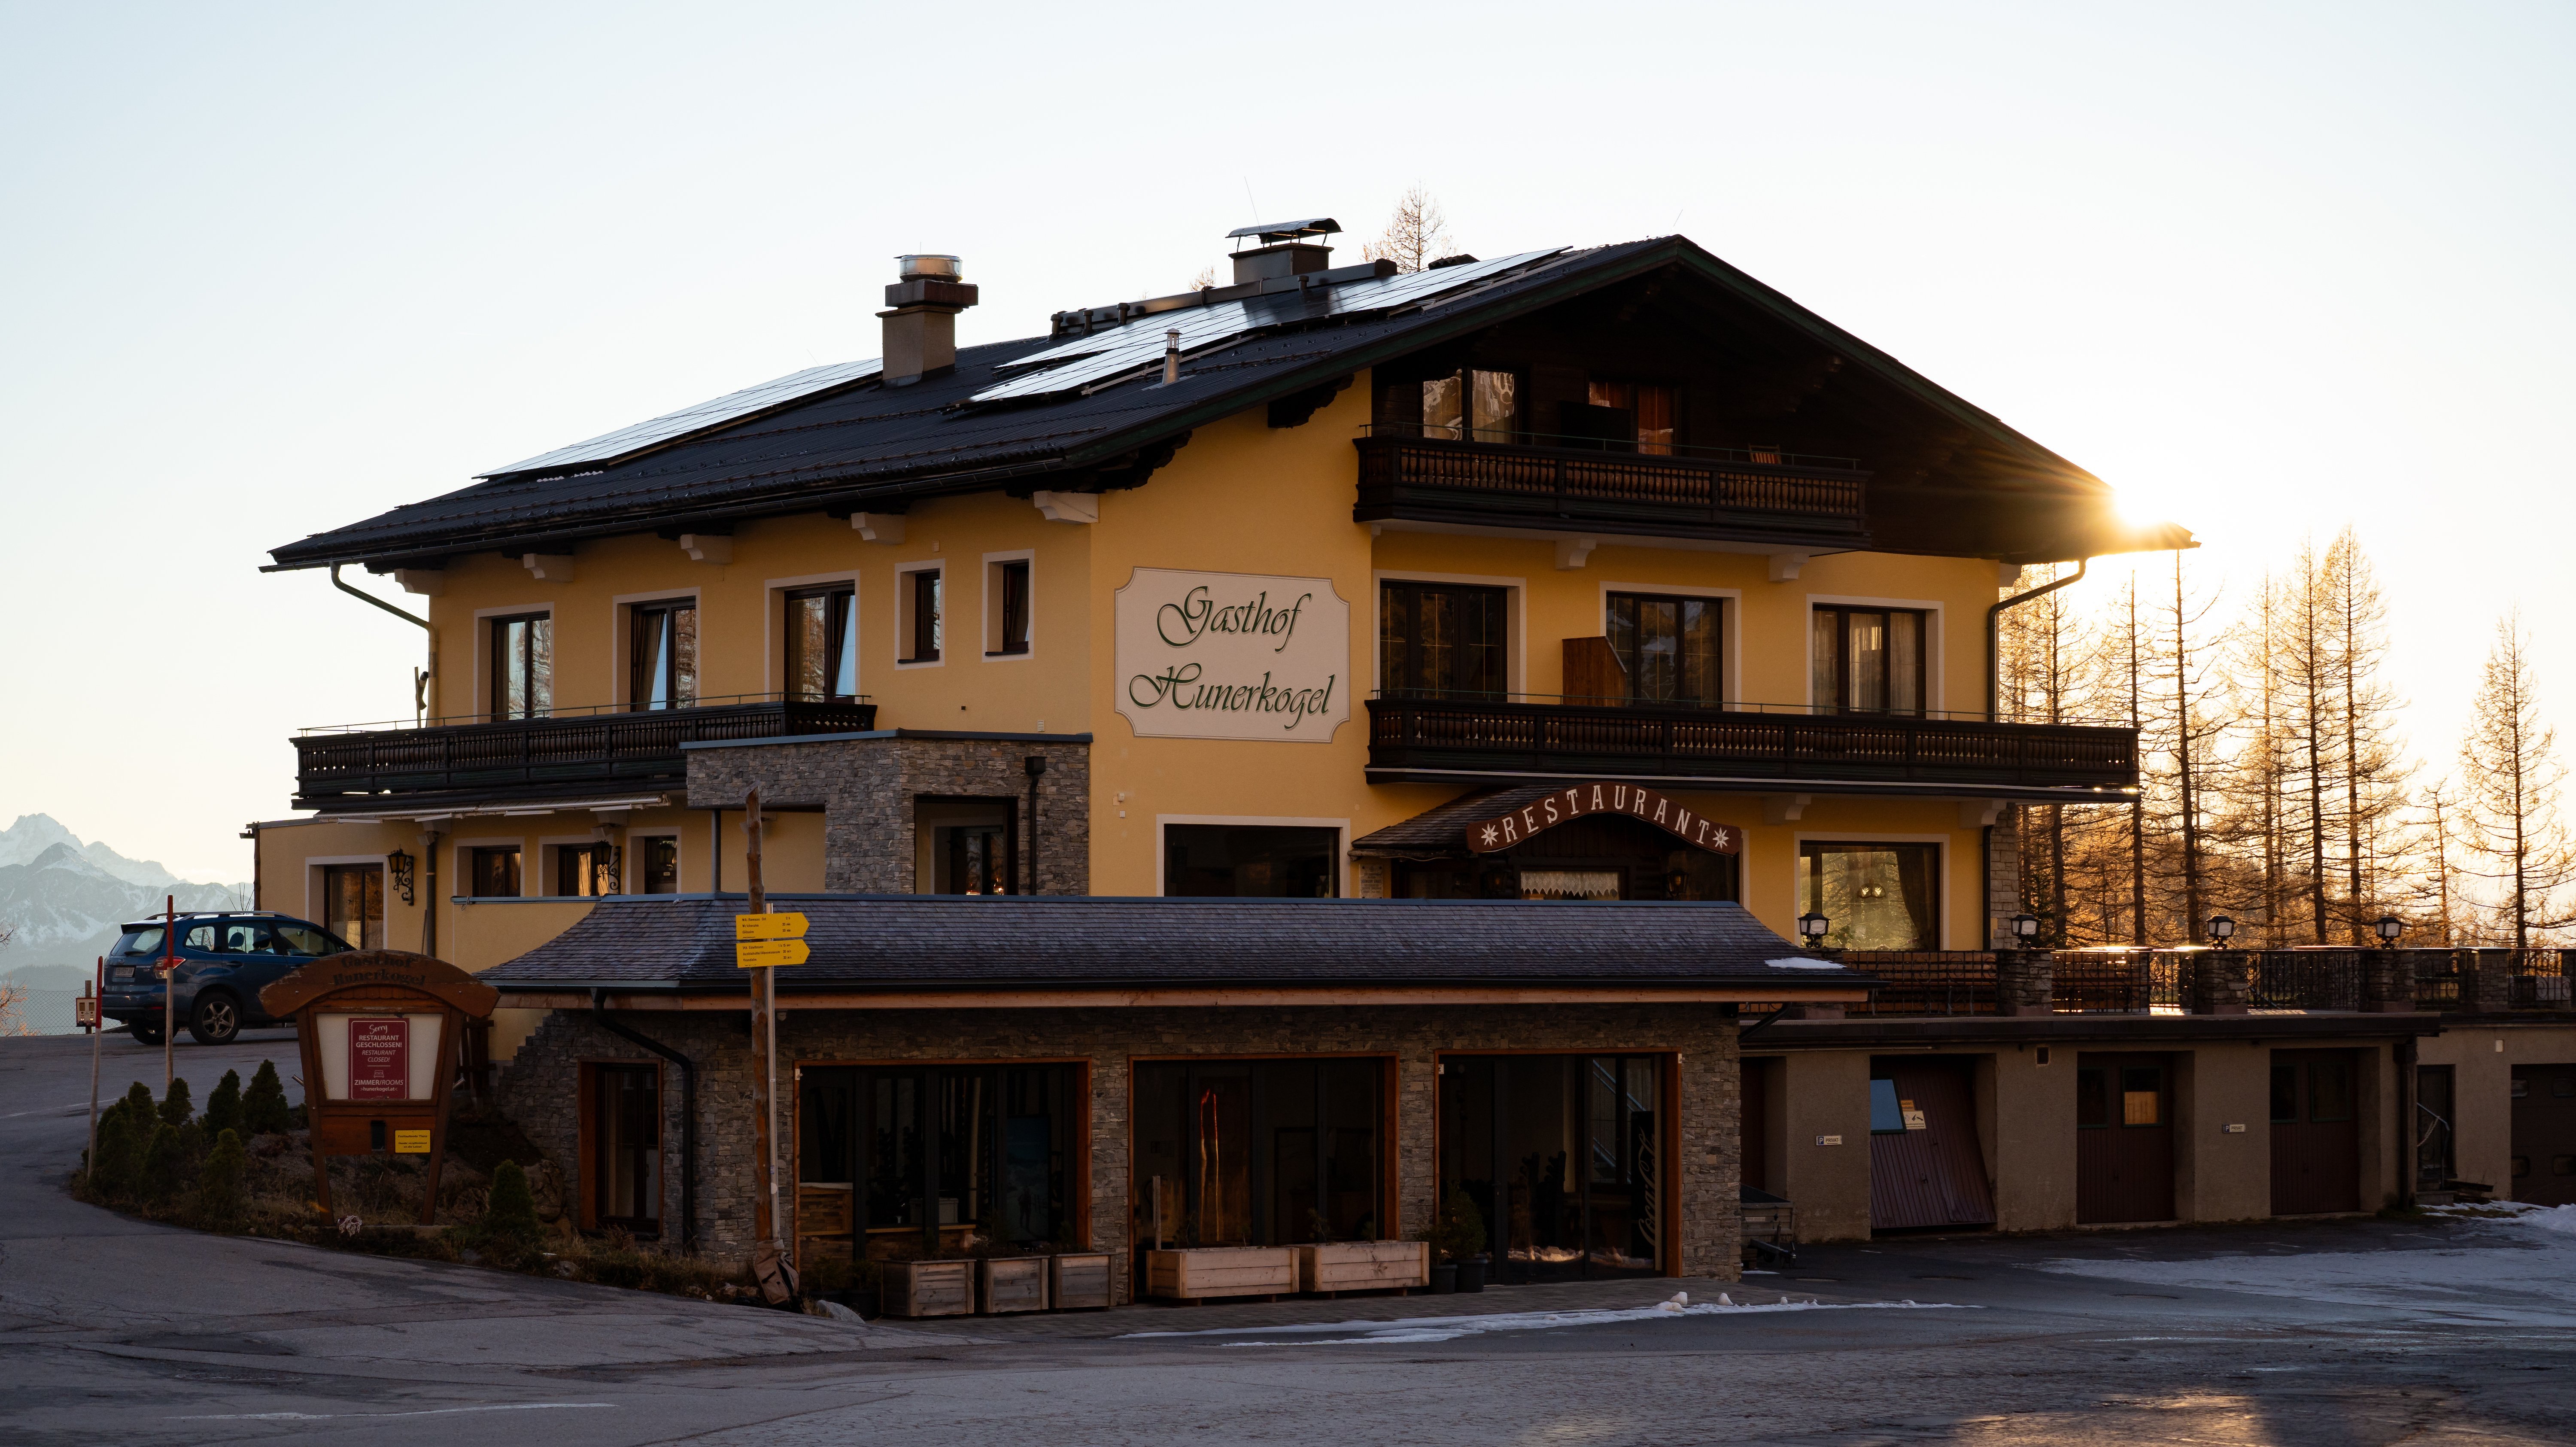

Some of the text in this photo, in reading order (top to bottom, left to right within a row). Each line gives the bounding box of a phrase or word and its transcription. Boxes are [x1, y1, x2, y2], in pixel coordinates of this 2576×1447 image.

[1157, 586, 1312, 653] Gasthof
[1129, 662, 1336, 731] Hunerkogel
[1502, 784, 1710, 845] RESTAURANT
[332, 968, 427, 986] Hunerkogel
[341, 954, 413, 968] Gasthof
[369, 1024, 388, 1034] Sorry
[1638, 1125, 1656, 1247] Coca-Cl
